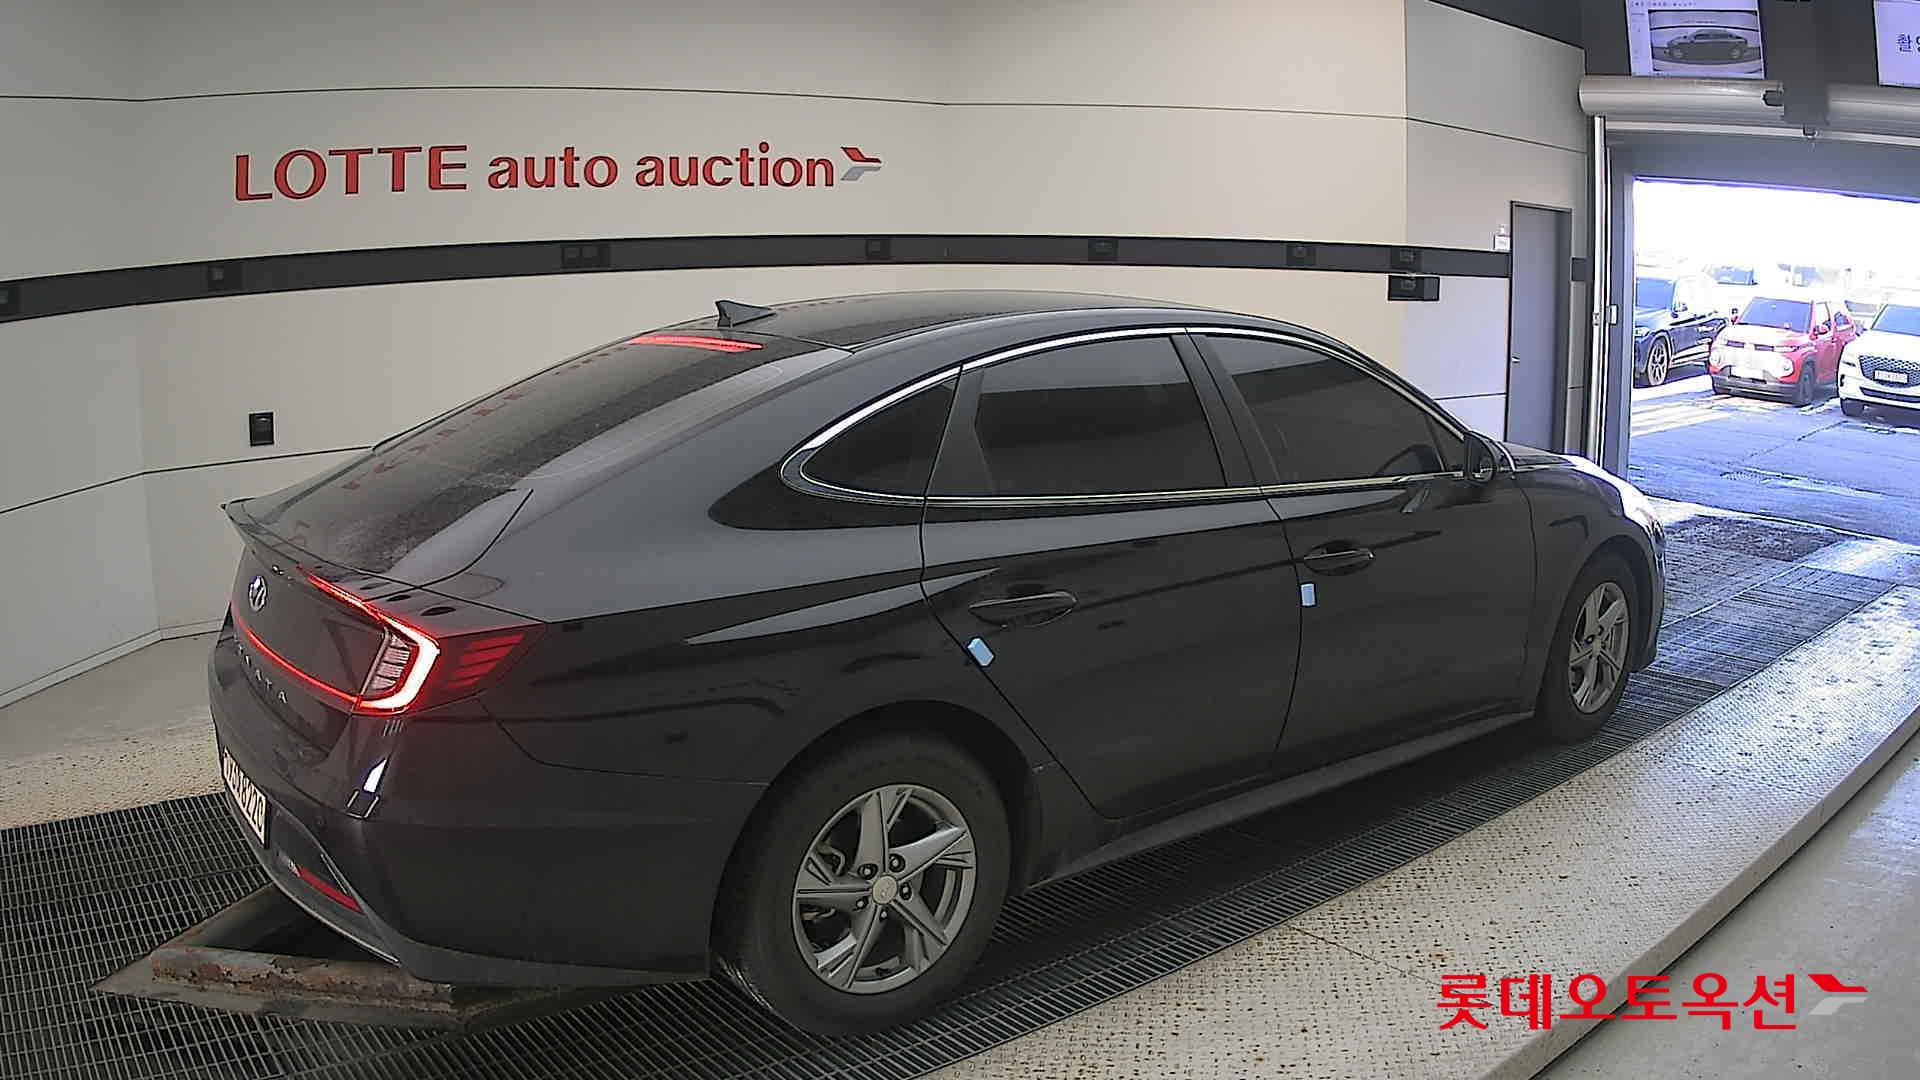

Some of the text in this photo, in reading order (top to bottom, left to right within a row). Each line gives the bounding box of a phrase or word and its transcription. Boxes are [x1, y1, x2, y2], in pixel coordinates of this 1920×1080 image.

[235, 141, 834, 201] LOTTE auto auction
